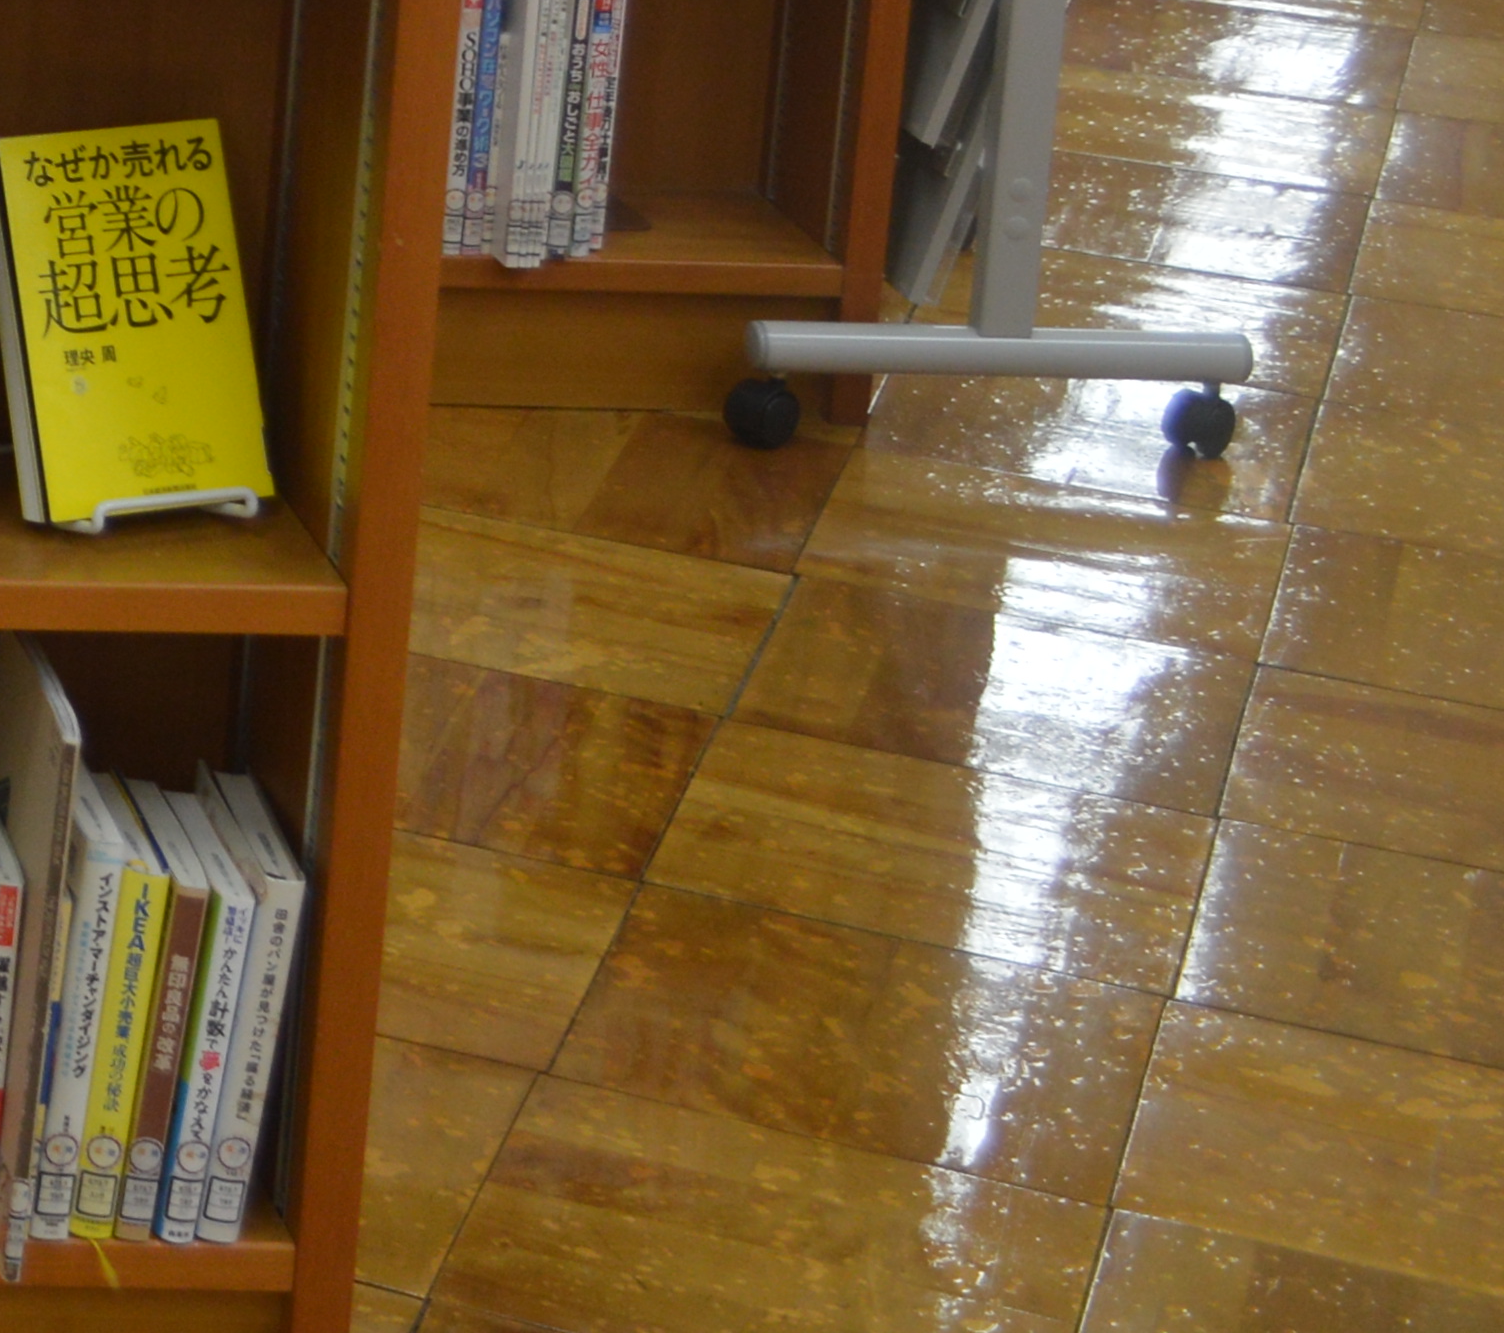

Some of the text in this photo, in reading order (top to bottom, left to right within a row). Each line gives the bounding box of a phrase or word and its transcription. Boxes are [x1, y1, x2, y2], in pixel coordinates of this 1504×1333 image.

[23, 135, 213, 188] なぜか売れる
[43, 186, 206, 261] 営業の
[38, 244, 231, 338] 超思考
[64, 347, 96, 368] 理央
